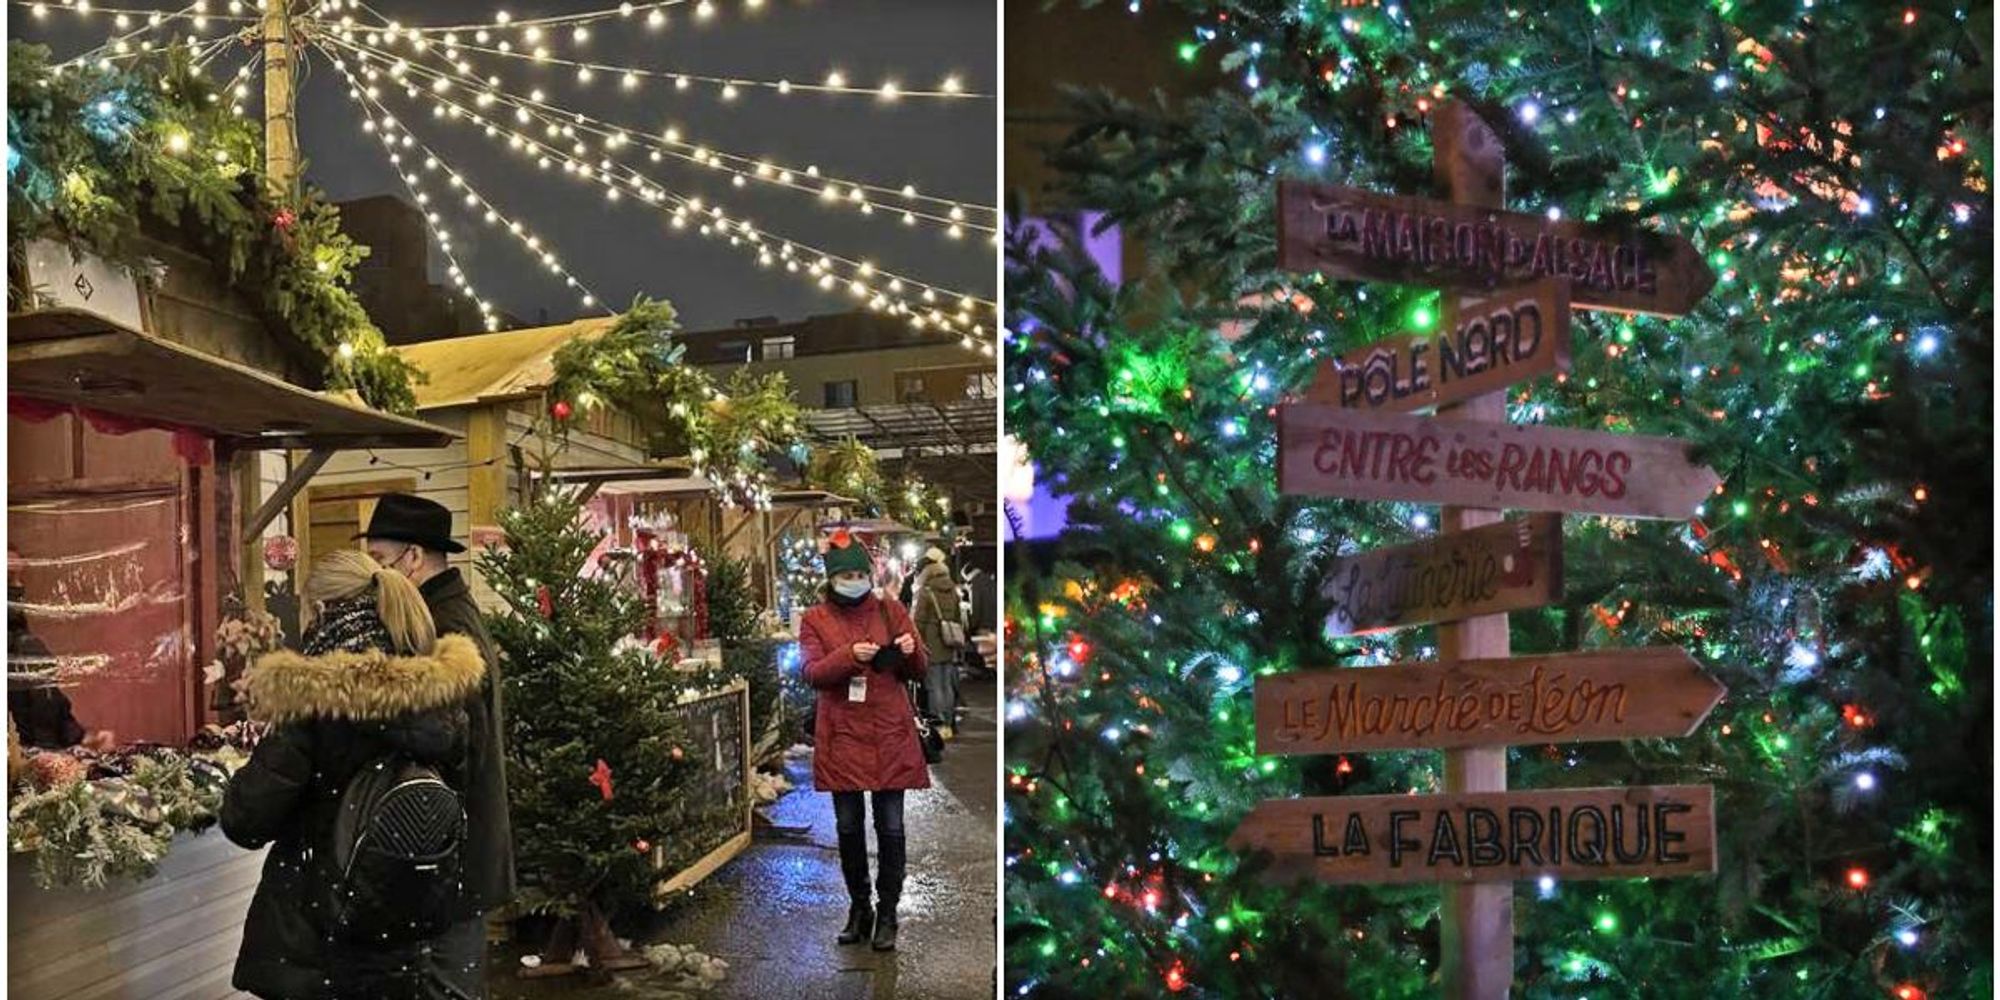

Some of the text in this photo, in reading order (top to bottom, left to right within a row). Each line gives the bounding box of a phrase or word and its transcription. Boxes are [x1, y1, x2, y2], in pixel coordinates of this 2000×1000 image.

[1325, 212, 1358, 241] LA
[1360, 208, 1500, 272] MAISON
[1340, 302, 1542, 408] PÔLE NORD
[1314, 426, 1440, 485] ENTRE
[1496, 443, 1632, 499] RANGS
[1284, 665, 1628, 742] LE Marché DE Léon
[1312, 803, 1694, 868] LA FABRIQUE
